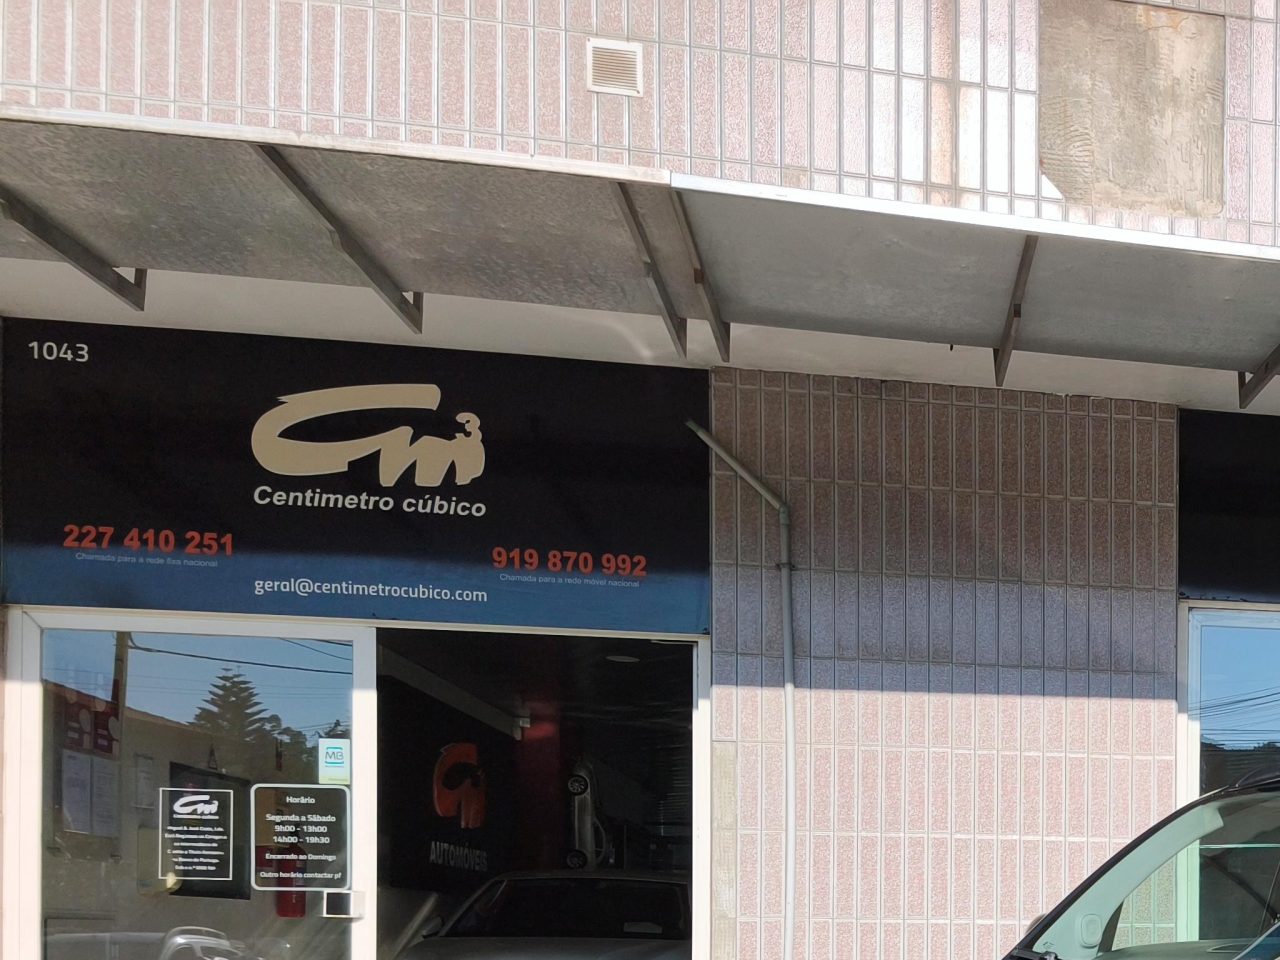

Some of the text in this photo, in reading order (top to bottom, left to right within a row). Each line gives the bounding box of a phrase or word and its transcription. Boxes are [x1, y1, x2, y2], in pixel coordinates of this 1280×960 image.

[28, 340, 90, 363] 1043
[253, 486, 487, 517] Centimetro cúbico
[63, 524, 234, 556] 227 410 251
[75, 552, 116, 562] Chamada
[117, 555, 137, 565] para
[183, 559, 218, 567] nacional
[492, 546, 647, 577] 919 870 992
[500, 573, 537, 582] Chamada
[538, 576, 556, 584] para
[608, 579, 640, 588] nacional
[254, 578, 488, 602] geral@centimetrocubico.com
[325, 751, 345, 761] MB
[286, 796, 316, 804] Horário
[265, 813, 300, 822] Segunda
[307, 814, 337, 822] Sábado
[302, 825, 328, 833] 13h00
[273, 836, 298, 844] 14h00
[305, 836, 330, 844] 19h30
[308, 853, 337, 861] Domingo
